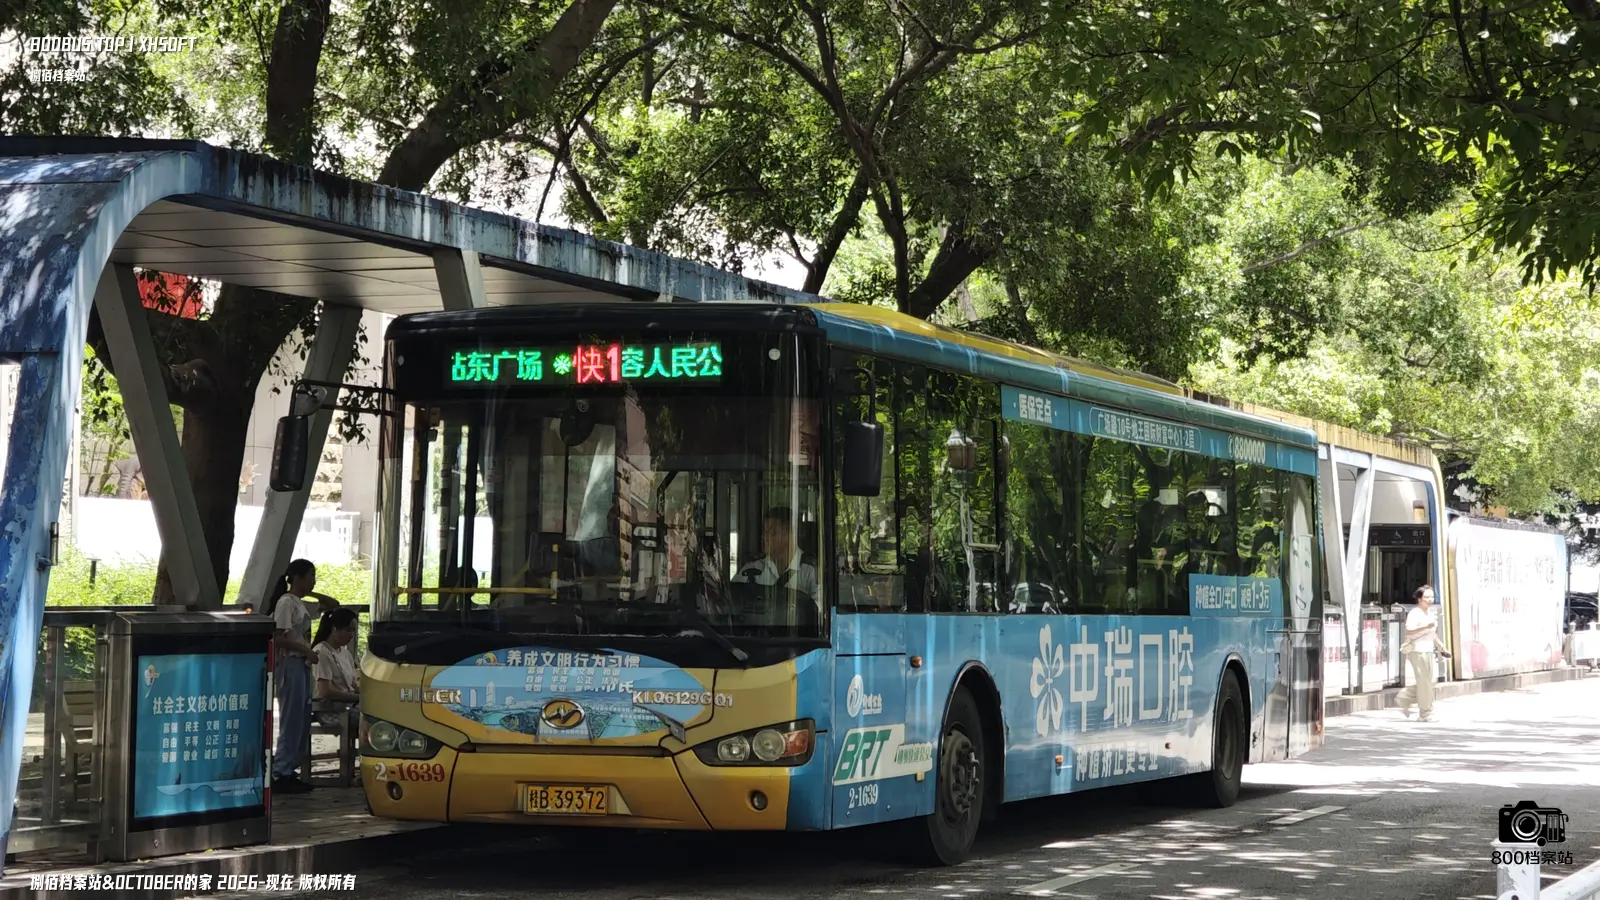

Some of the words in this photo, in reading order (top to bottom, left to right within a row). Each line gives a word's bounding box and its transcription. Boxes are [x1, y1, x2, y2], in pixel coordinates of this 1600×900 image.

[1019, 393, 1053, 424] 医保定点
[507, 649, 640, 668] 养成文明行为习惯
[1070, 624, 1194, 733] 中瑞口腔
[153, 693, 249, 715] 社会主义核心价值观
[400, 687, 462, 704] HIGER
[632, 690, 733, 707] KLQ6129GQ1
[834, 729, 892, 781] BRT
[375, 761, 445, 782] 2-1639
